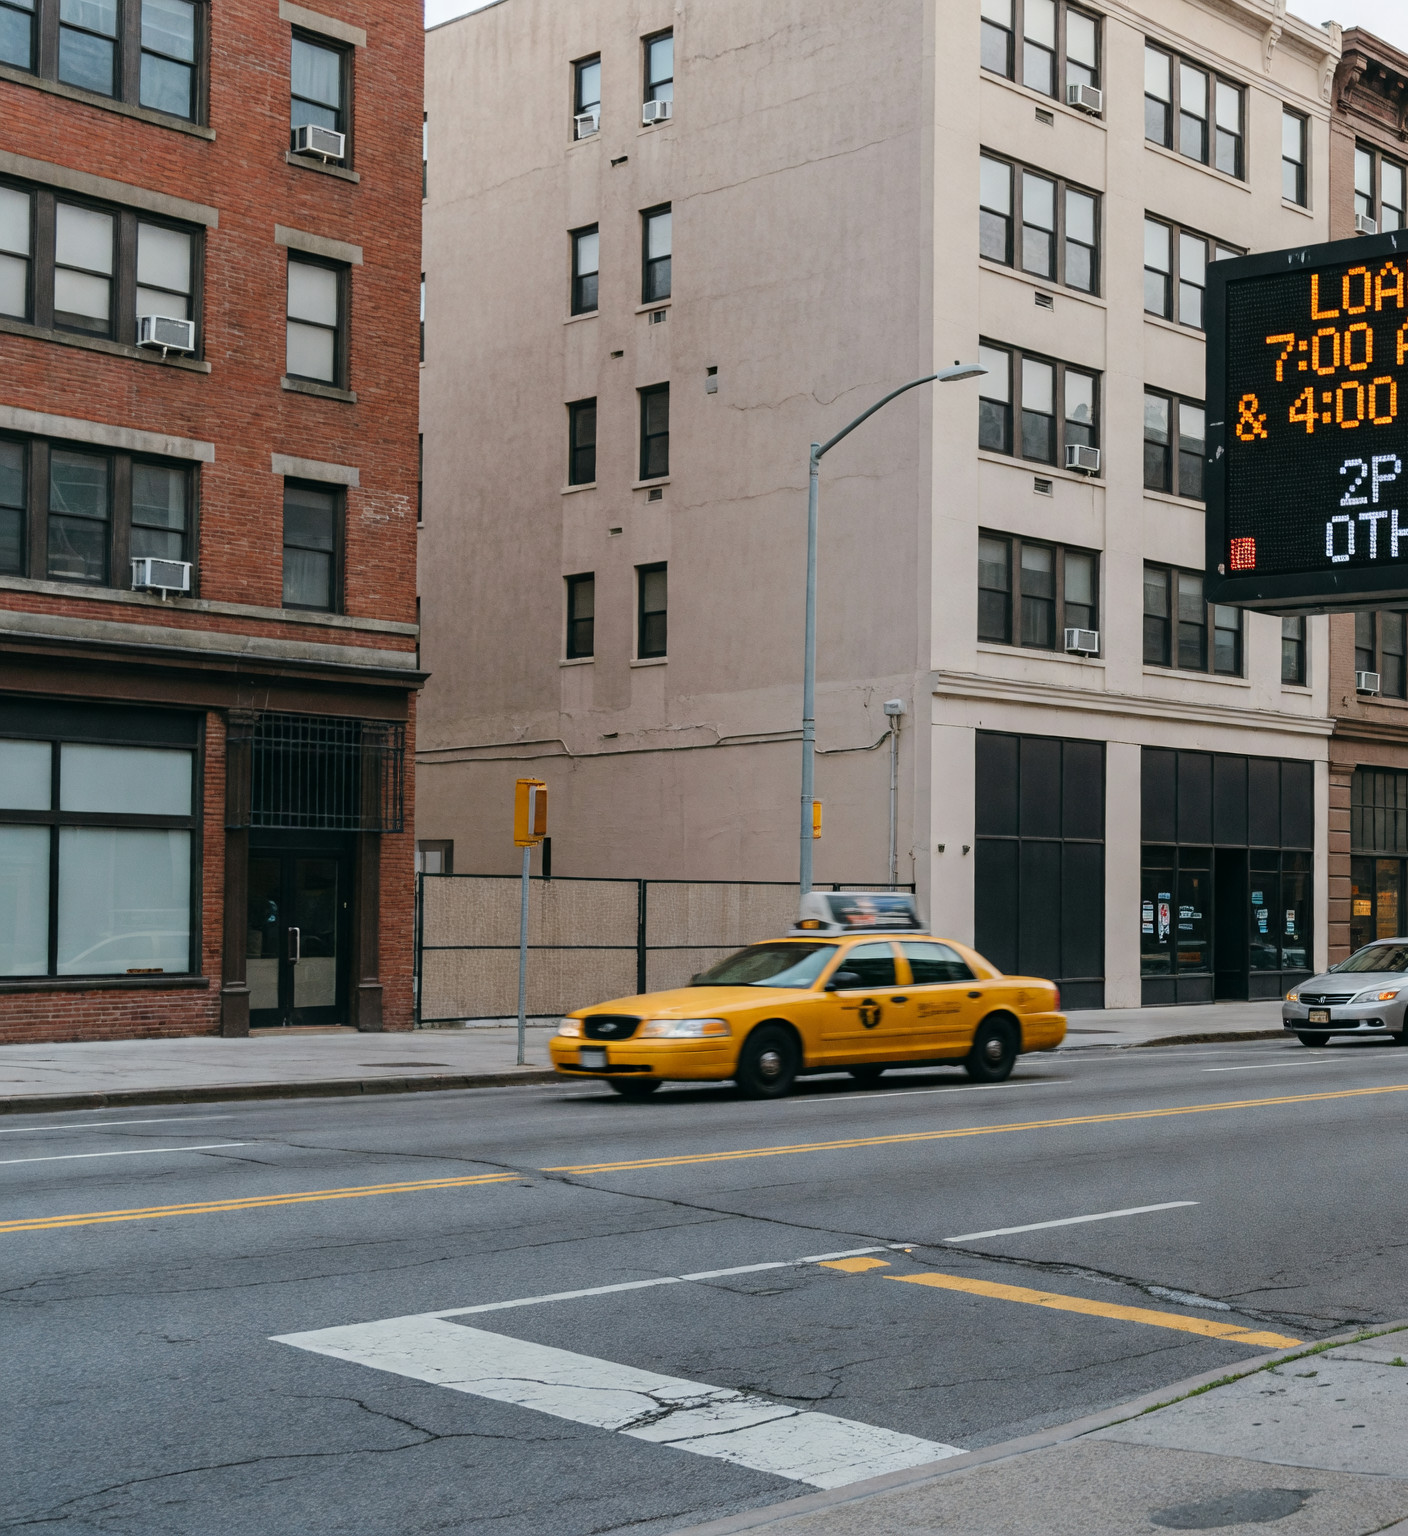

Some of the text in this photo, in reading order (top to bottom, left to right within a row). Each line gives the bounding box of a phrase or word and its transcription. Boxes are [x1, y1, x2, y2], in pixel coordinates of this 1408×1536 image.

[1266, 322, 1373, 381] 7:00
[1236, 394, 1267, 441] &
[1289, 374, 1397, 433] 4:00
[1340, 454, 1401, 506] 2P
